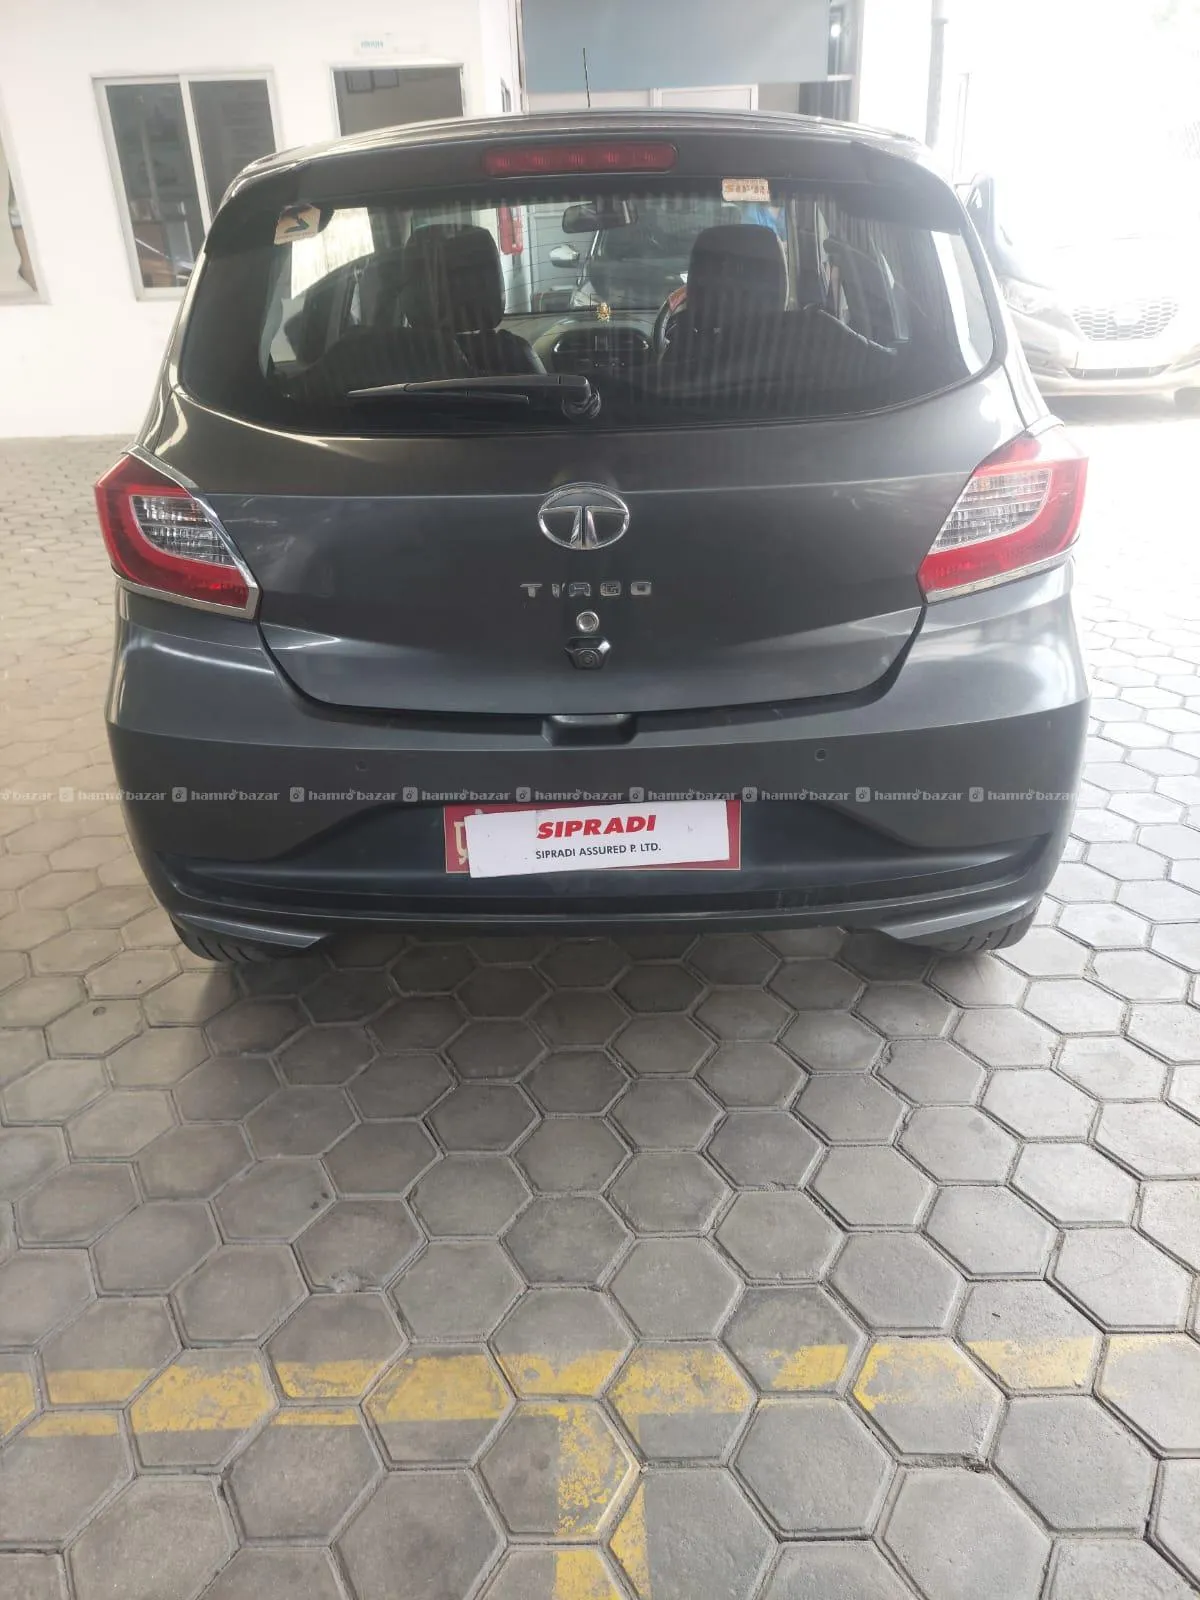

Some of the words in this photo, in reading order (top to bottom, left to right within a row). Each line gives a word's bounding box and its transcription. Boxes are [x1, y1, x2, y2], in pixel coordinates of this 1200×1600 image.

[519, 581, 652, 598] TIAGO
[537, 815, 657, 840] SIPRADI
[536, 848, 576, 859] SIPRADI
[580, 845, 627, 857] ASSURED
[630, 844, 637, 852] P.
[640, 842, 662, 852] LTD.
